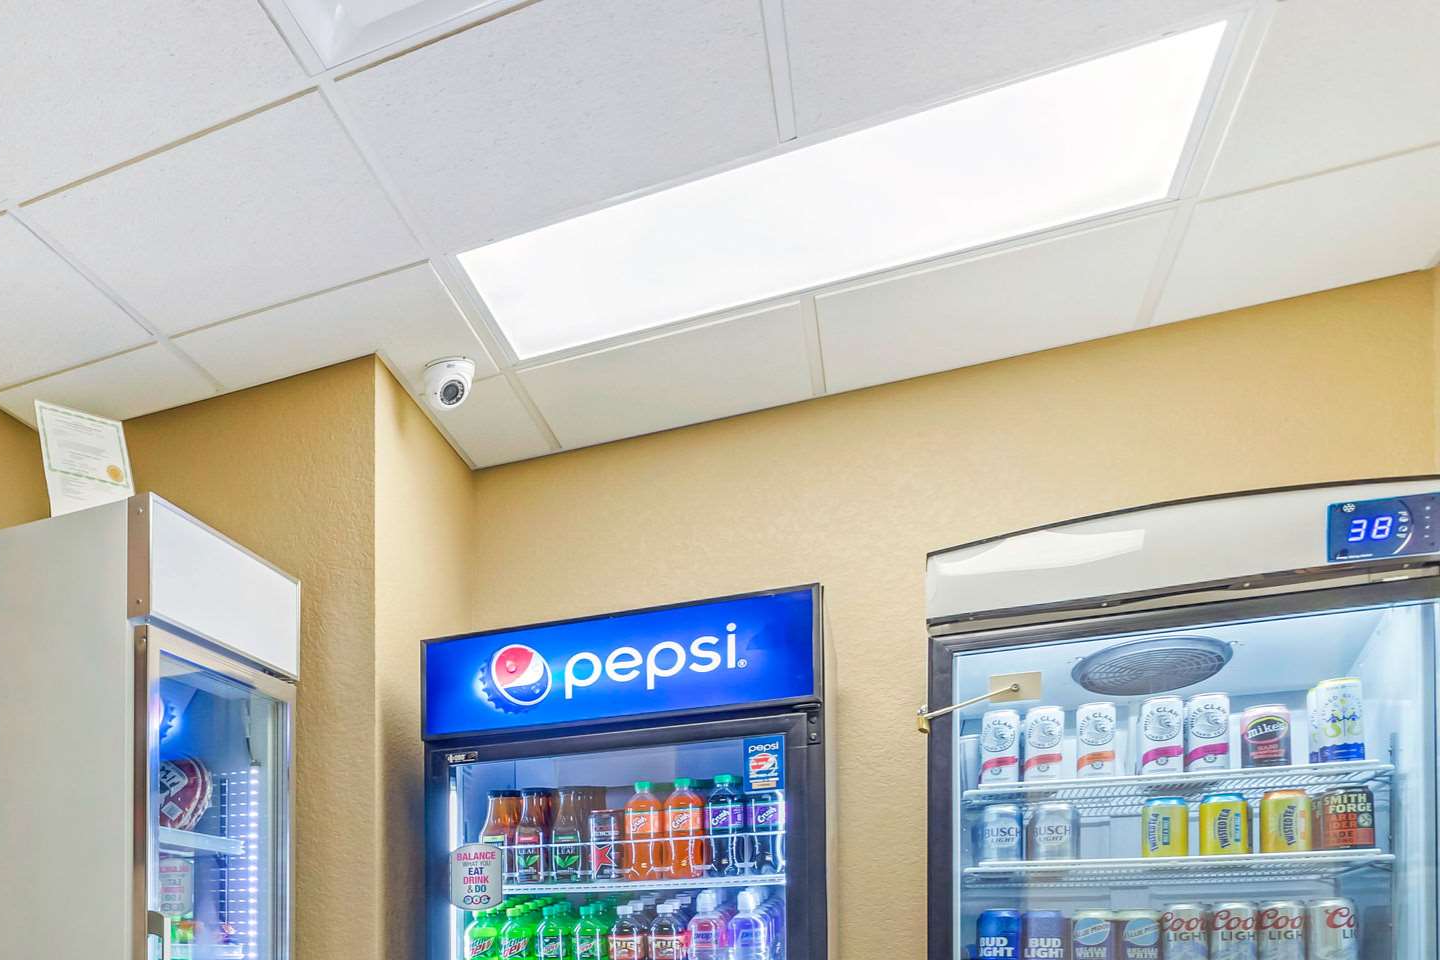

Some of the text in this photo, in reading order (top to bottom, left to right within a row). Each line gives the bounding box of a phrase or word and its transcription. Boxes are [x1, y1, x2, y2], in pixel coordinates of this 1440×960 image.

[1348, 516, 1393, 542] 38
[564, 622, 738, 699] pepsi
[749, 741, 779, 753] pepsi
[1325, 793, 1367, 805] SMITH
[1329, 802, 1372, 813] FORGE
[711, 809, 730, 826] Crush
[985, 826, 1021, 838] BUSCH
[1033, 825, 1071, 837] BUSCH
[456, 851, 497, 862] BALANCE
[468, 867, 485, 876] EAT
[463, 876, 490, 885] DRINK
[474, 884, 487, 893] DO
[1160, 911, 1208, 932] Coor
[1213, 909, 1257, 931] Coo
[1260, 907, 1304, 931] Coo
[1220, 931, 1256, 941] LIGH
[1268, 930, 1303, 940] LIGH
[979, 936, 1008, 947] BUD
[1028, 937, 1061, 948] BUD
[1024, 948, 1064, 958] LIGHT
